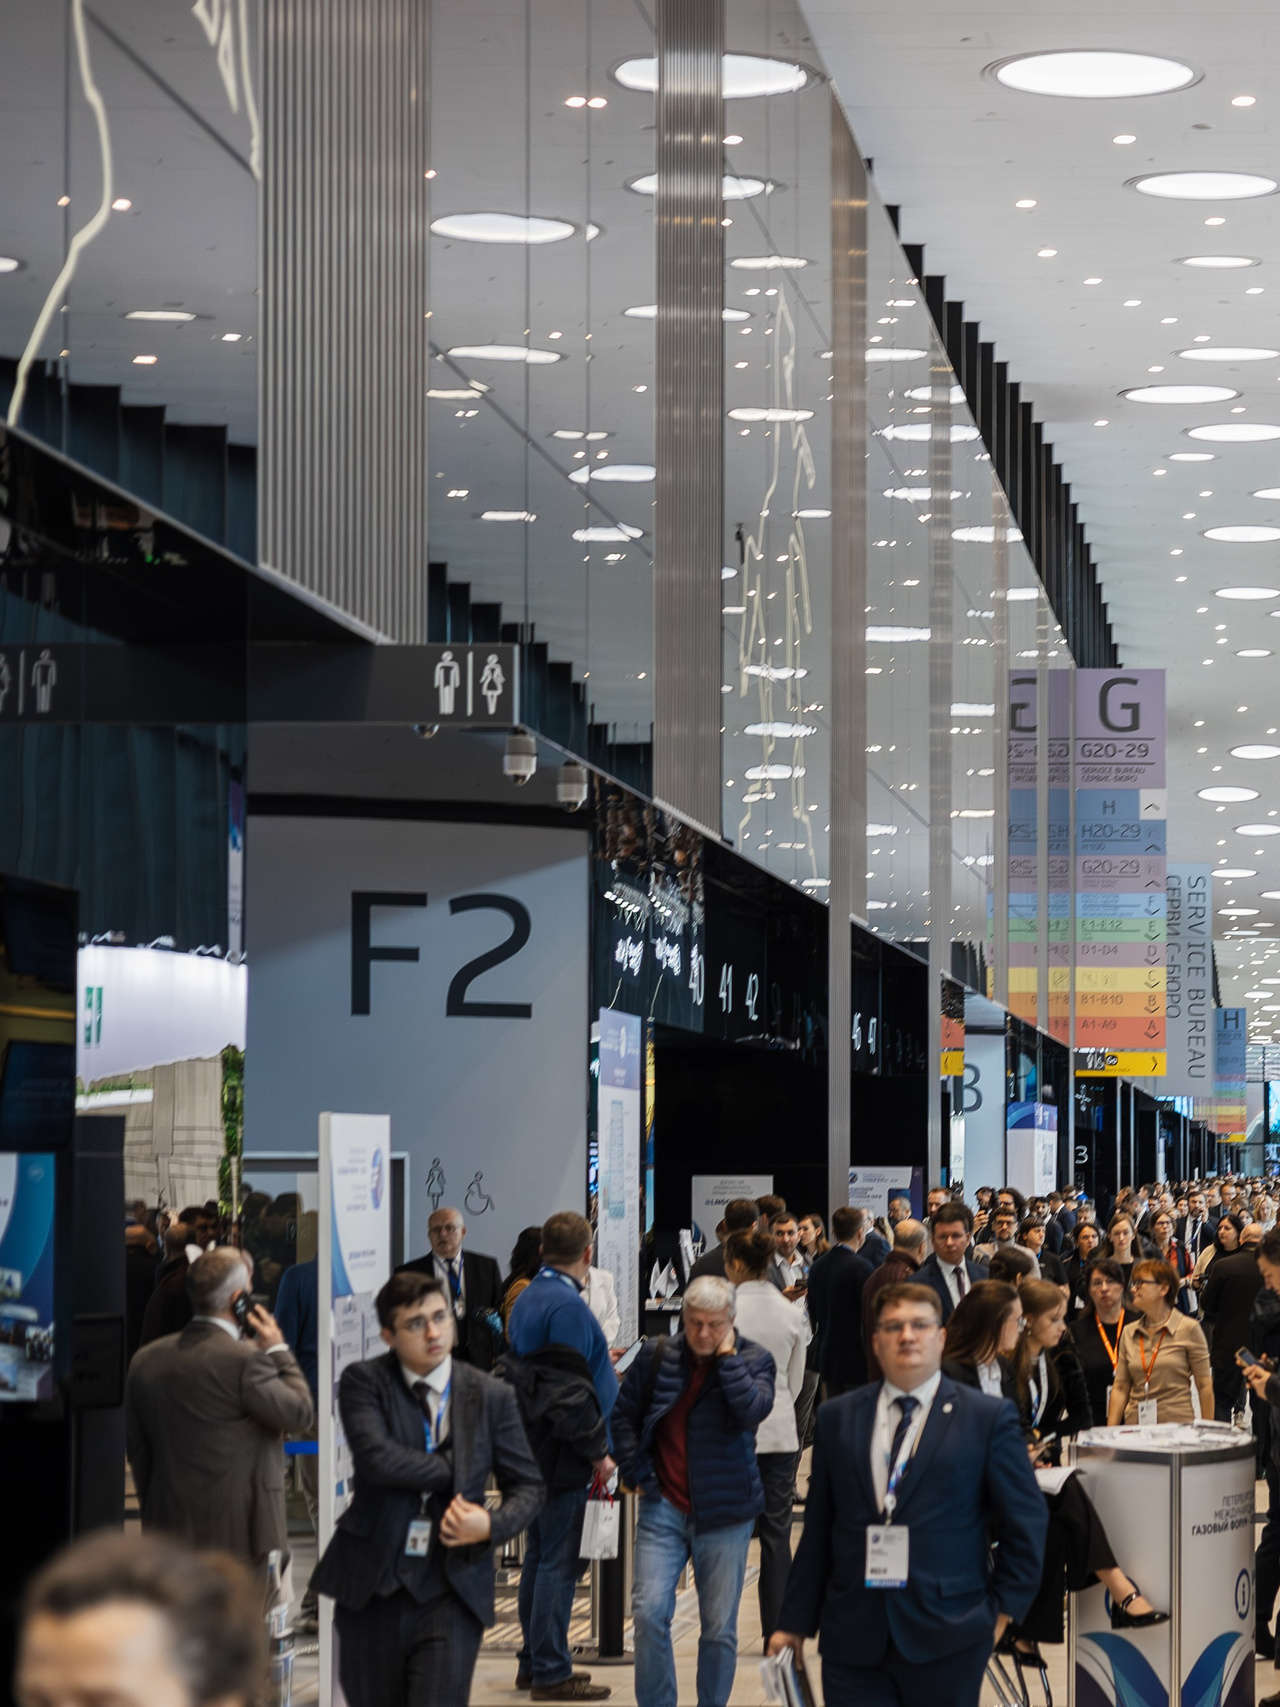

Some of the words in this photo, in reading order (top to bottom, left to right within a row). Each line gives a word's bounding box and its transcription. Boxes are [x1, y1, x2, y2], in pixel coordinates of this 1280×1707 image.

[1099, 677, 1141, 733] G
[1080, 743, 1149, 758] G20-29
[1102, 800, 1116, 815] H
[1081, 824, 1141, 838] H20-29
[1082, 860, 1140, 874] G20-29
[1147, 895, 1156, 907] F
[1081, 920, 1123, 930] E1-E12
[1148, 921, 1156, 932] E
[1187, 875, 1206, 978] SERVICE
[1081, 945, 1118, 955] D1-D4
[1147, 945, 1157, 956] D
[1166, 875, 1181, 1019] СЕРВИС-БЮРО
[350, 891, 533, 1019] F2
[1148, 970, 1156, 982] C
[1081, 995, 1123, 1005] B1-B10
[1148, 995, 1156, 1006] B
[1081, 1020, 1117, 1030] A1-A9
[1148, 1020, 1156, 1031] A
[1223, 1011, 1239, 1029] H
[1187, 988, 1206, 1079] BUREAU
[1075, 1145, 1088, 1164] 3
[1192, 1519, 1229, 1536] ГАЗОВЫЙ
